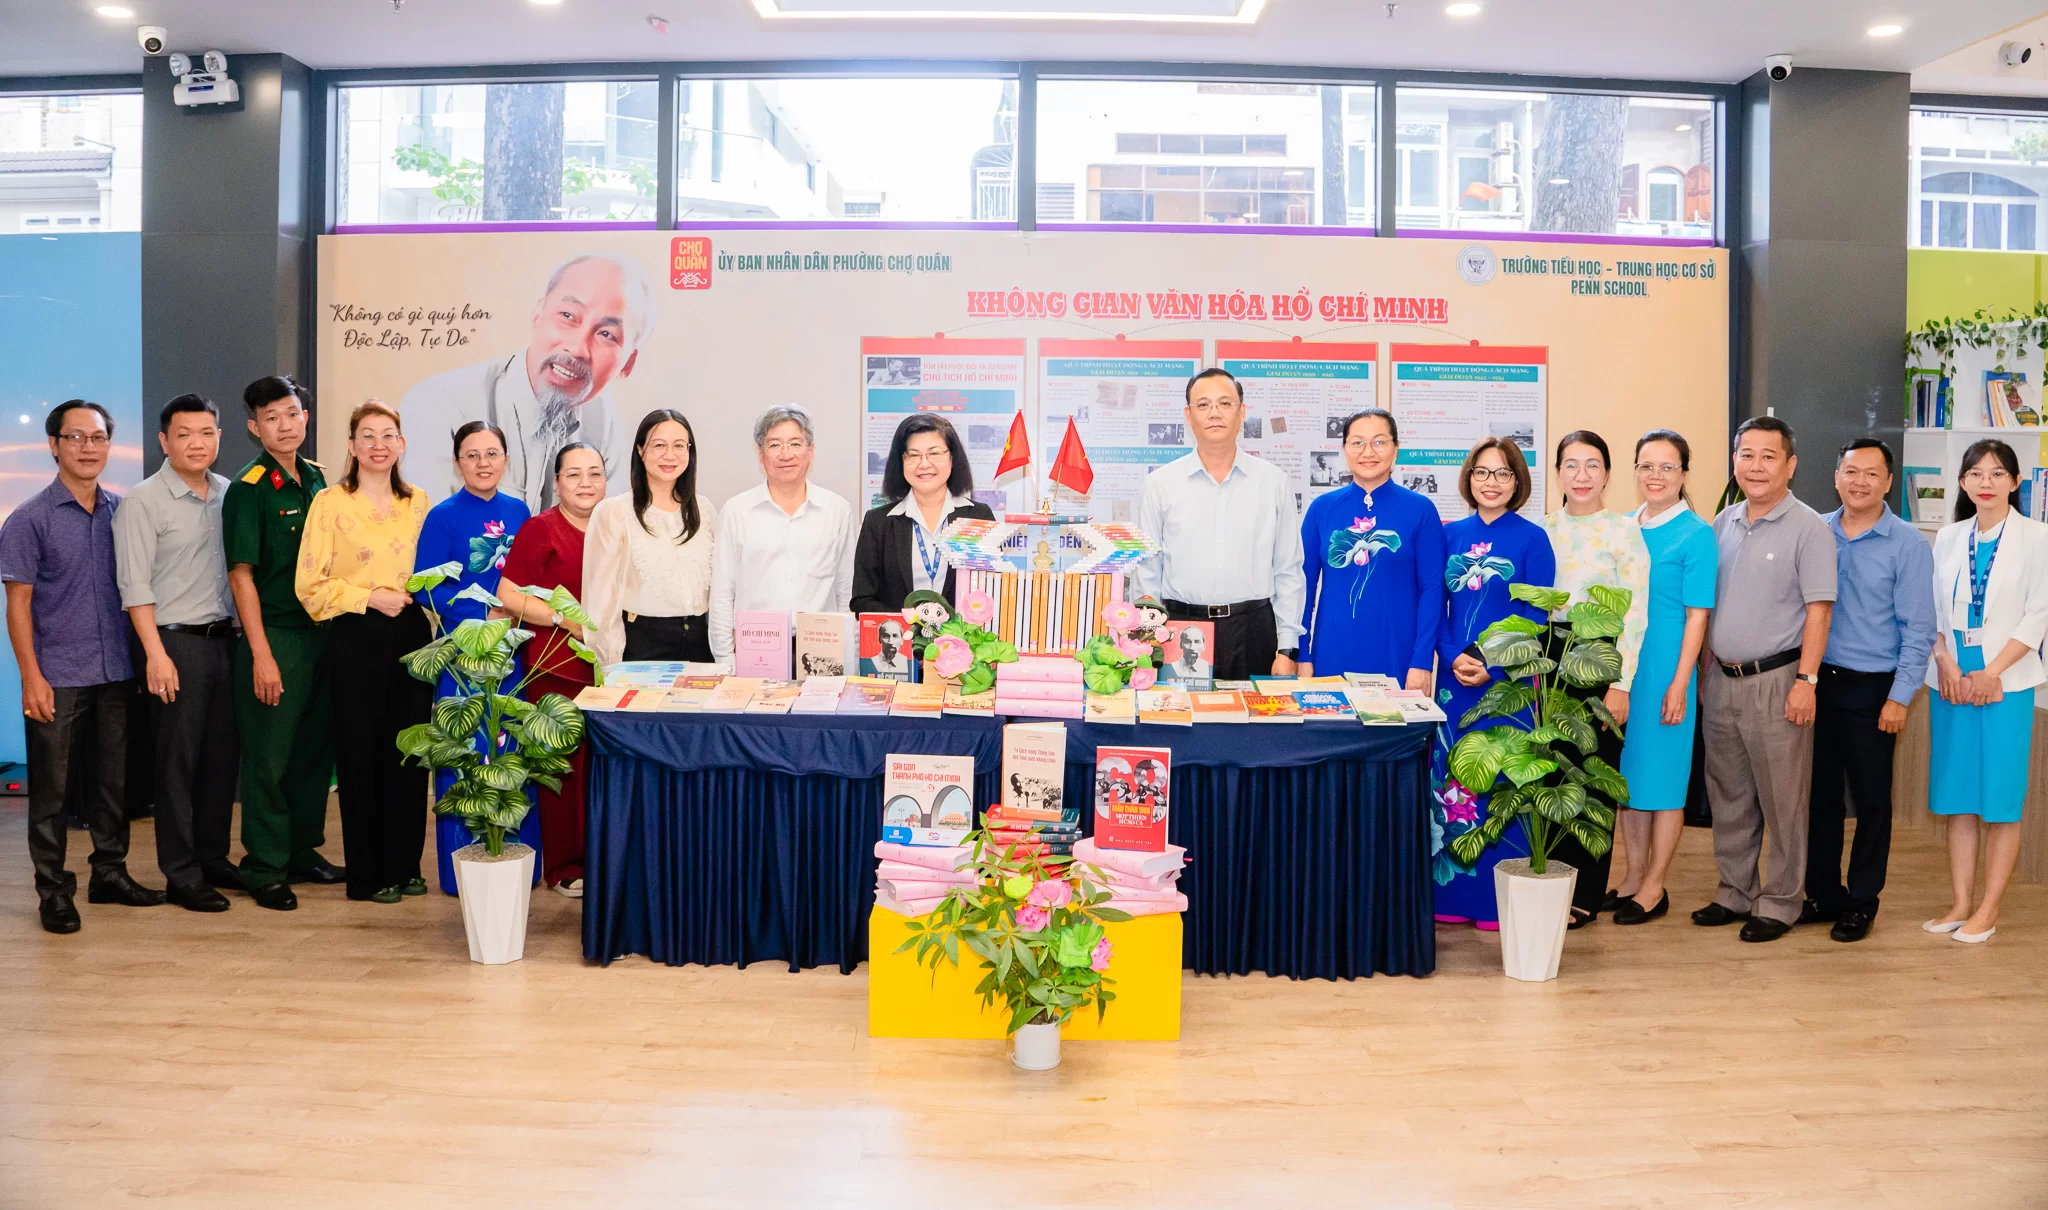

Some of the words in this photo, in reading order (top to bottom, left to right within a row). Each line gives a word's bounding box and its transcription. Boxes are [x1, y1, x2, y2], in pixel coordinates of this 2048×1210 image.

[679, 240, 704, 256] CHỢ
[718, 250, 734, 271] ỦY
[737, 255, 762, 271] BAN
[766, 250, 799, 271] NHÂN
[804, 250, 829, 271] DÂN
[833, 250, 883, 271] PHƯỜNG
[888, 253, 914, 275] CHỢ
[917, 251, 951, 272] QUÁN
[1501, 255, 1548, 275] TRƯỜNG
[1550, 256, 1575, 275] TIỂU
[1578, 260, 1601, 279] HỌC
[1616, 261, 1651, 277] TRUNG
[1655, 262, 1678, 281] HỌC
[1681, 262, 1696, 278] CƠ
[1699, 258, 1715, 279] SỞ
[1571, 280, 1600, 295] PENN
[1603, 281, 1648, 297] SCHOOL
[387, 307, 404, 321] có
[407, 307, 424, 325] gì
[428, 307, 456, 325] quý
[461, 303, 492, 320] hơn
[967, 287, 1066, 317] KHÔNG
[1073, 292, 1140, 318] GIAN
[1146, 289, 1202, 318] VĂN
[1207, 289, 1266, 319] HÓA
[1272, 287, 1312, 321] HỒ
[1318, 292, 1368, 321] CHÍ
[1373, 297, 1448, 323] MINH
[344, 329, 373, 350] Độc
[420, 328, 441, 349] Tự
